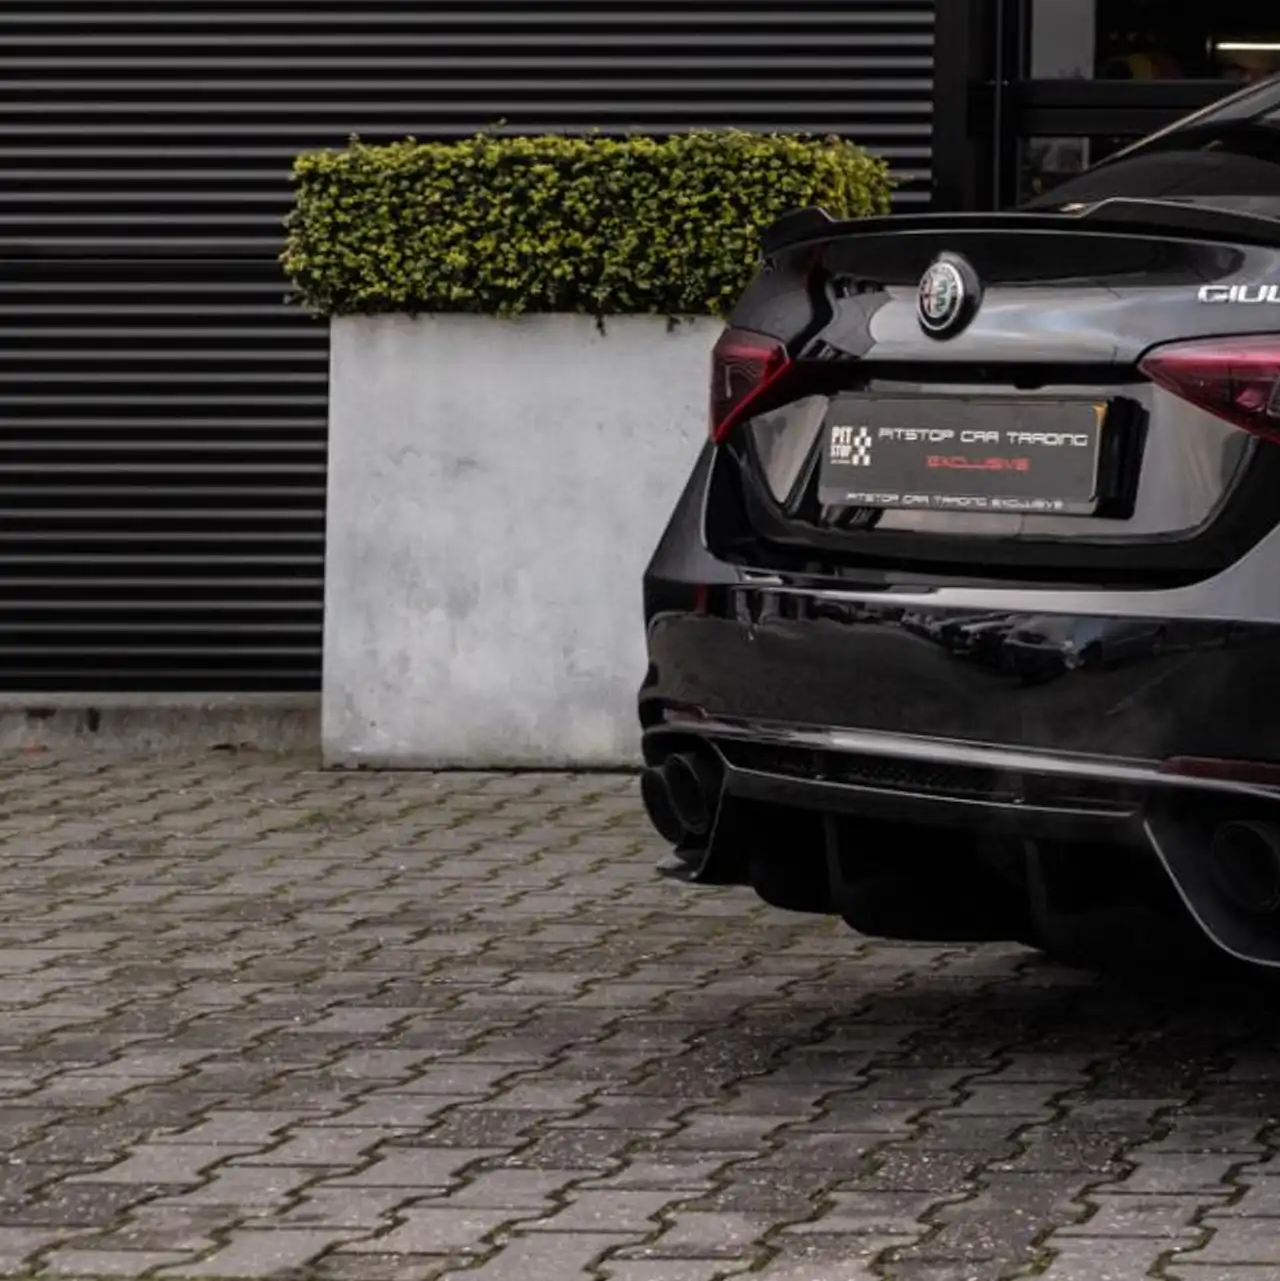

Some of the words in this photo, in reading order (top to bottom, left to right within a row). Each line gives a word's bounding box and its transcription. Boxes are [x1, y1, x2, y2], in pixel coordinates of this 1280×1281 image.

[831, 426, 853, 444] PIT
[877, 427, 955, 443] PITSTOP
[959, 430, 1000, 444] CAR
[1006, 431, 1089, 447] TRADING
